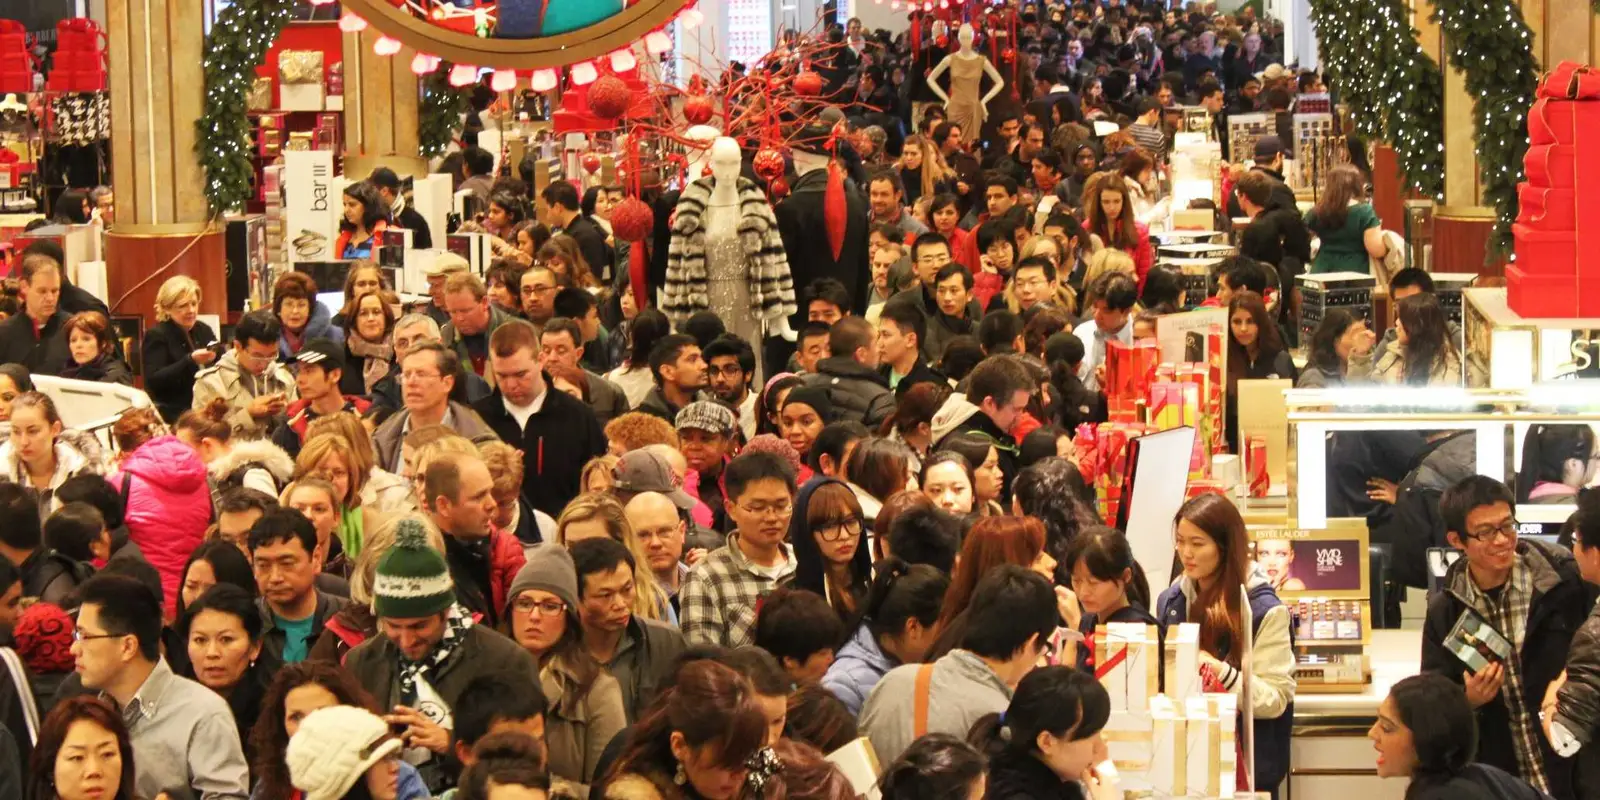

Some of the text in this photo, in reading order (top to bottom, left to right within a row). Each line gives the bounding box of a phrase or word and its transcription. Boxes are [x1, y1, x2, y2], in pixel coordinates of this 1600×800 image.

[310, 179, 327, 211] bar
[1516, 523, 1543, 534] UDER
[1280, 530, 1310, 538] LAUDER
[1316, 556, 1343, 566] SHINE
